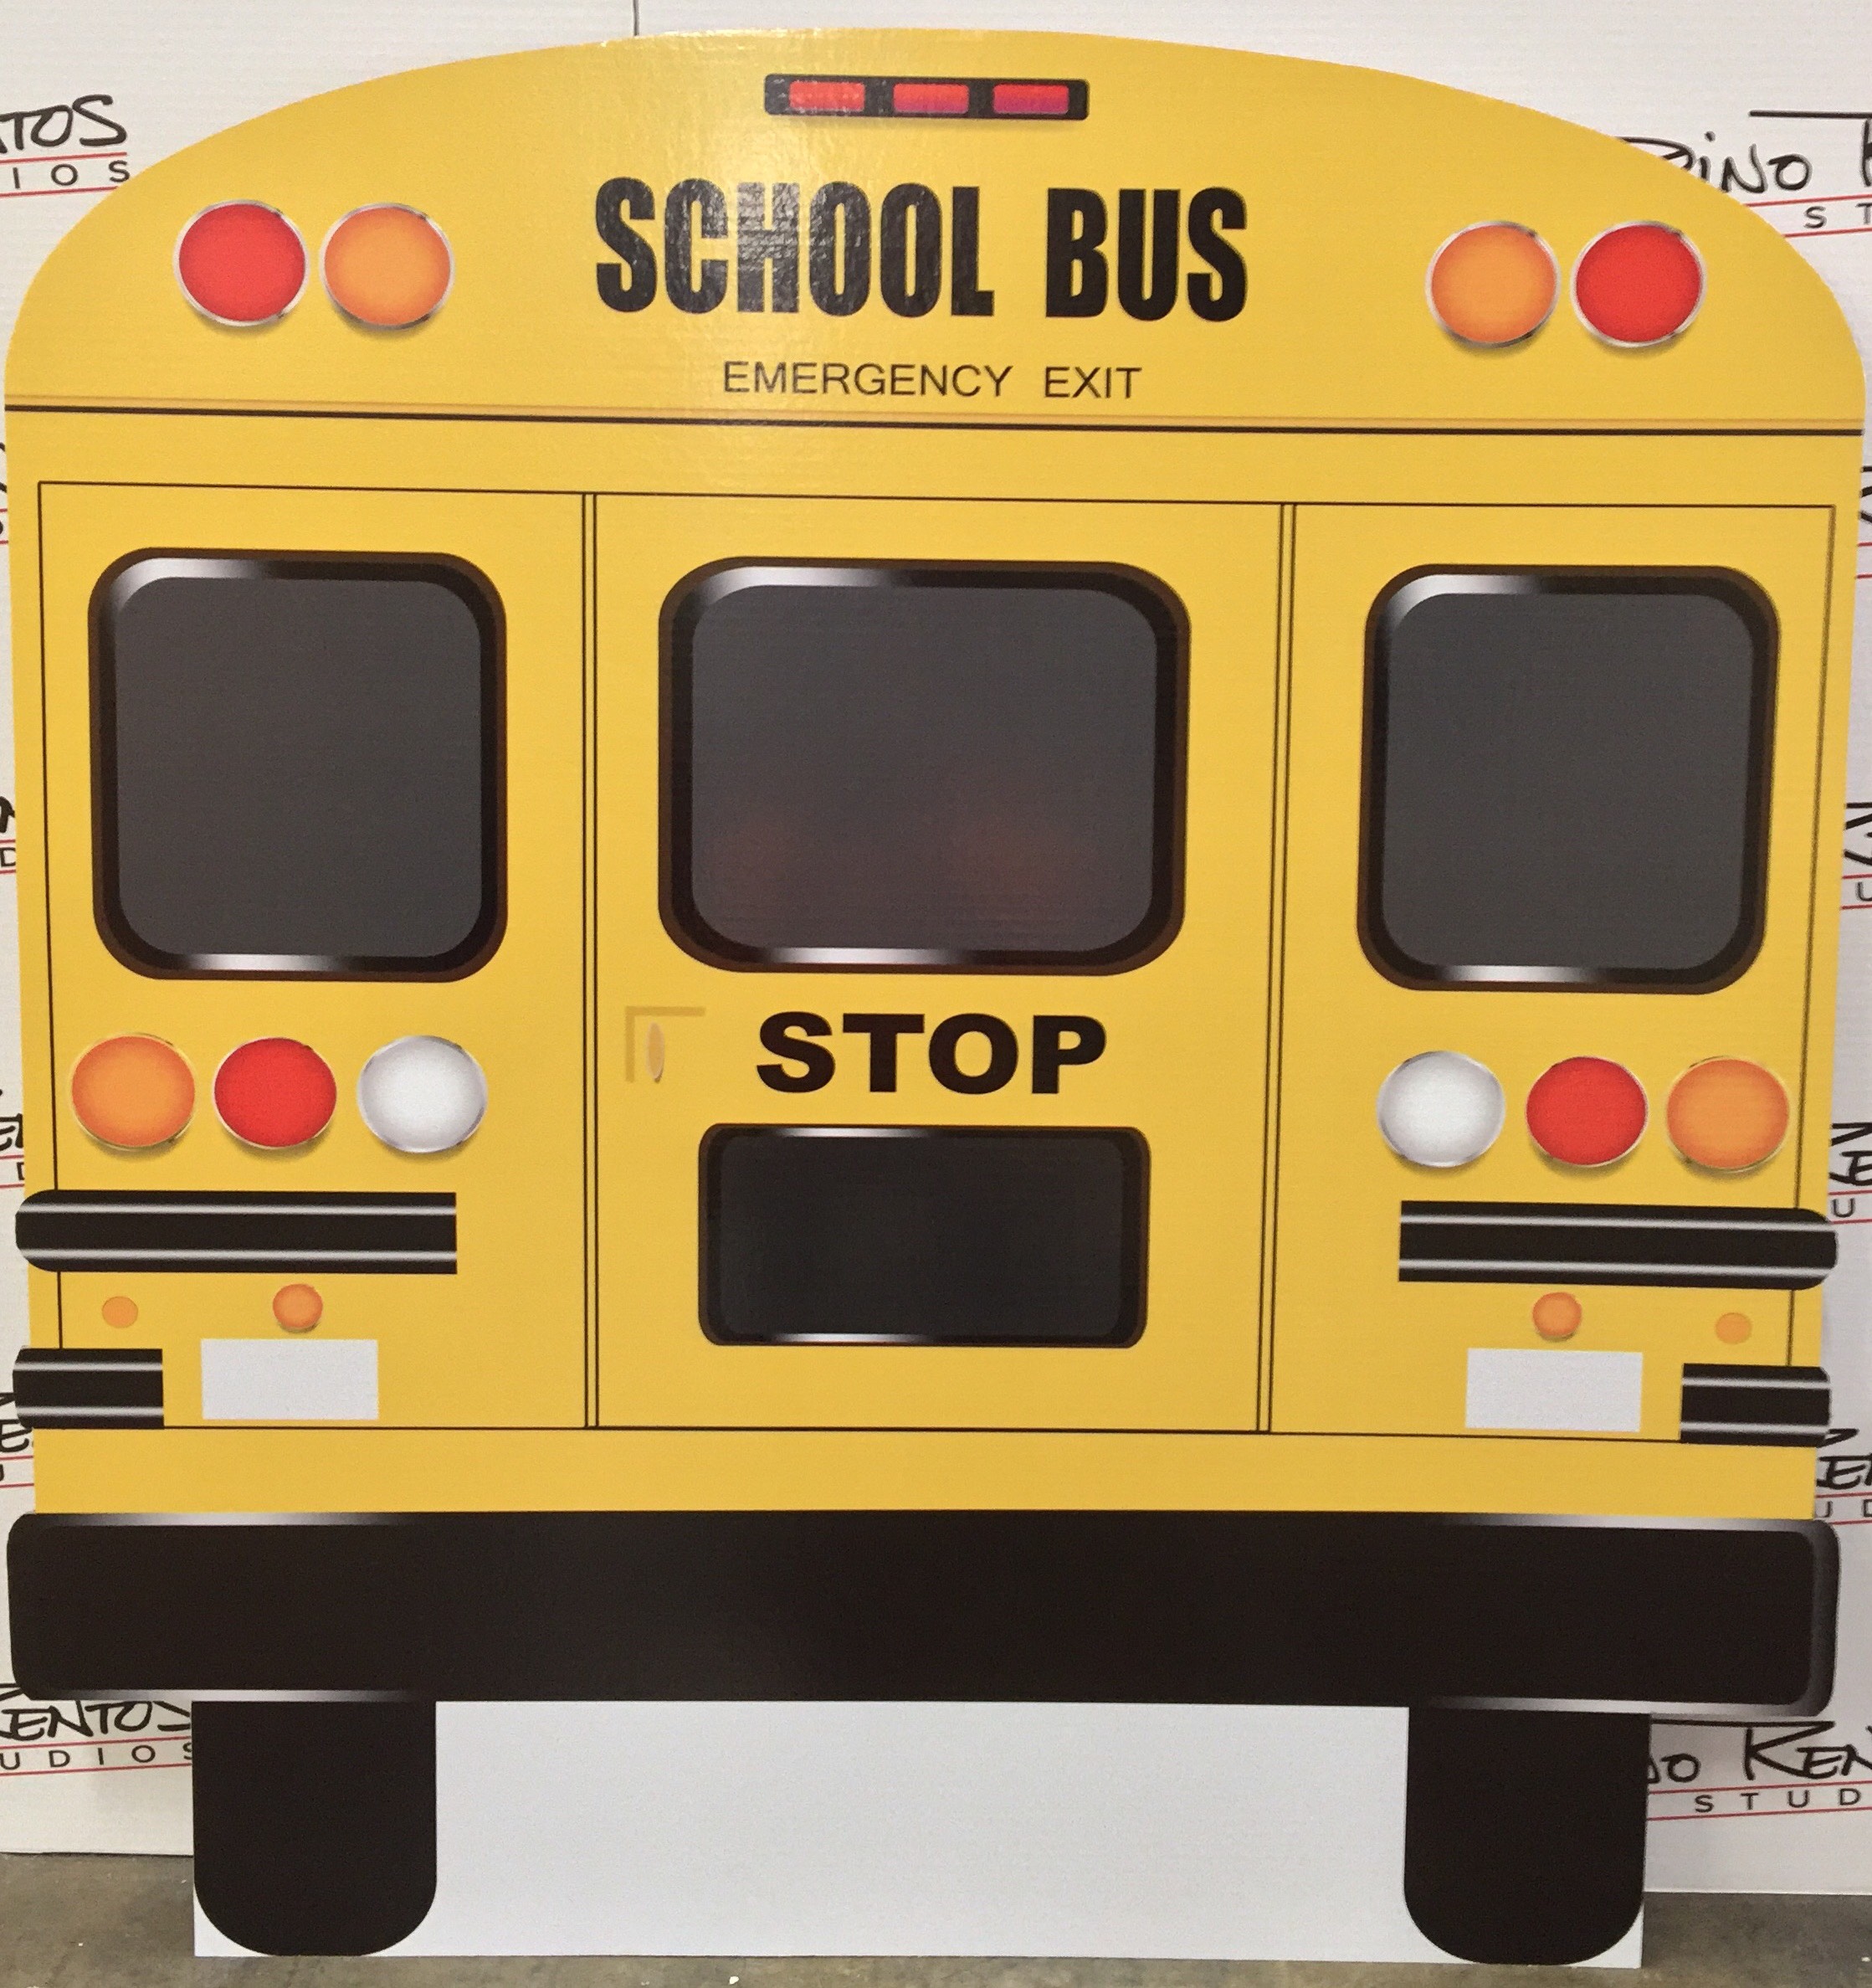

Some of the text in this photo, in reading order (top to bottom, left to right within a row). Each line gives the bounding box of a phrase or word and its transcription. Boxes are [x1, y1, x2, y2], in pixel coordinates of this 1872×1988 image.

[0, 94, 127, 154] TOS
[596, 177, 1247, 322] SCHOOL BUS
[725, 362, 1141, 398] EMERGENCY EXIT
[756, 1012, 1106, 1094] STOP
